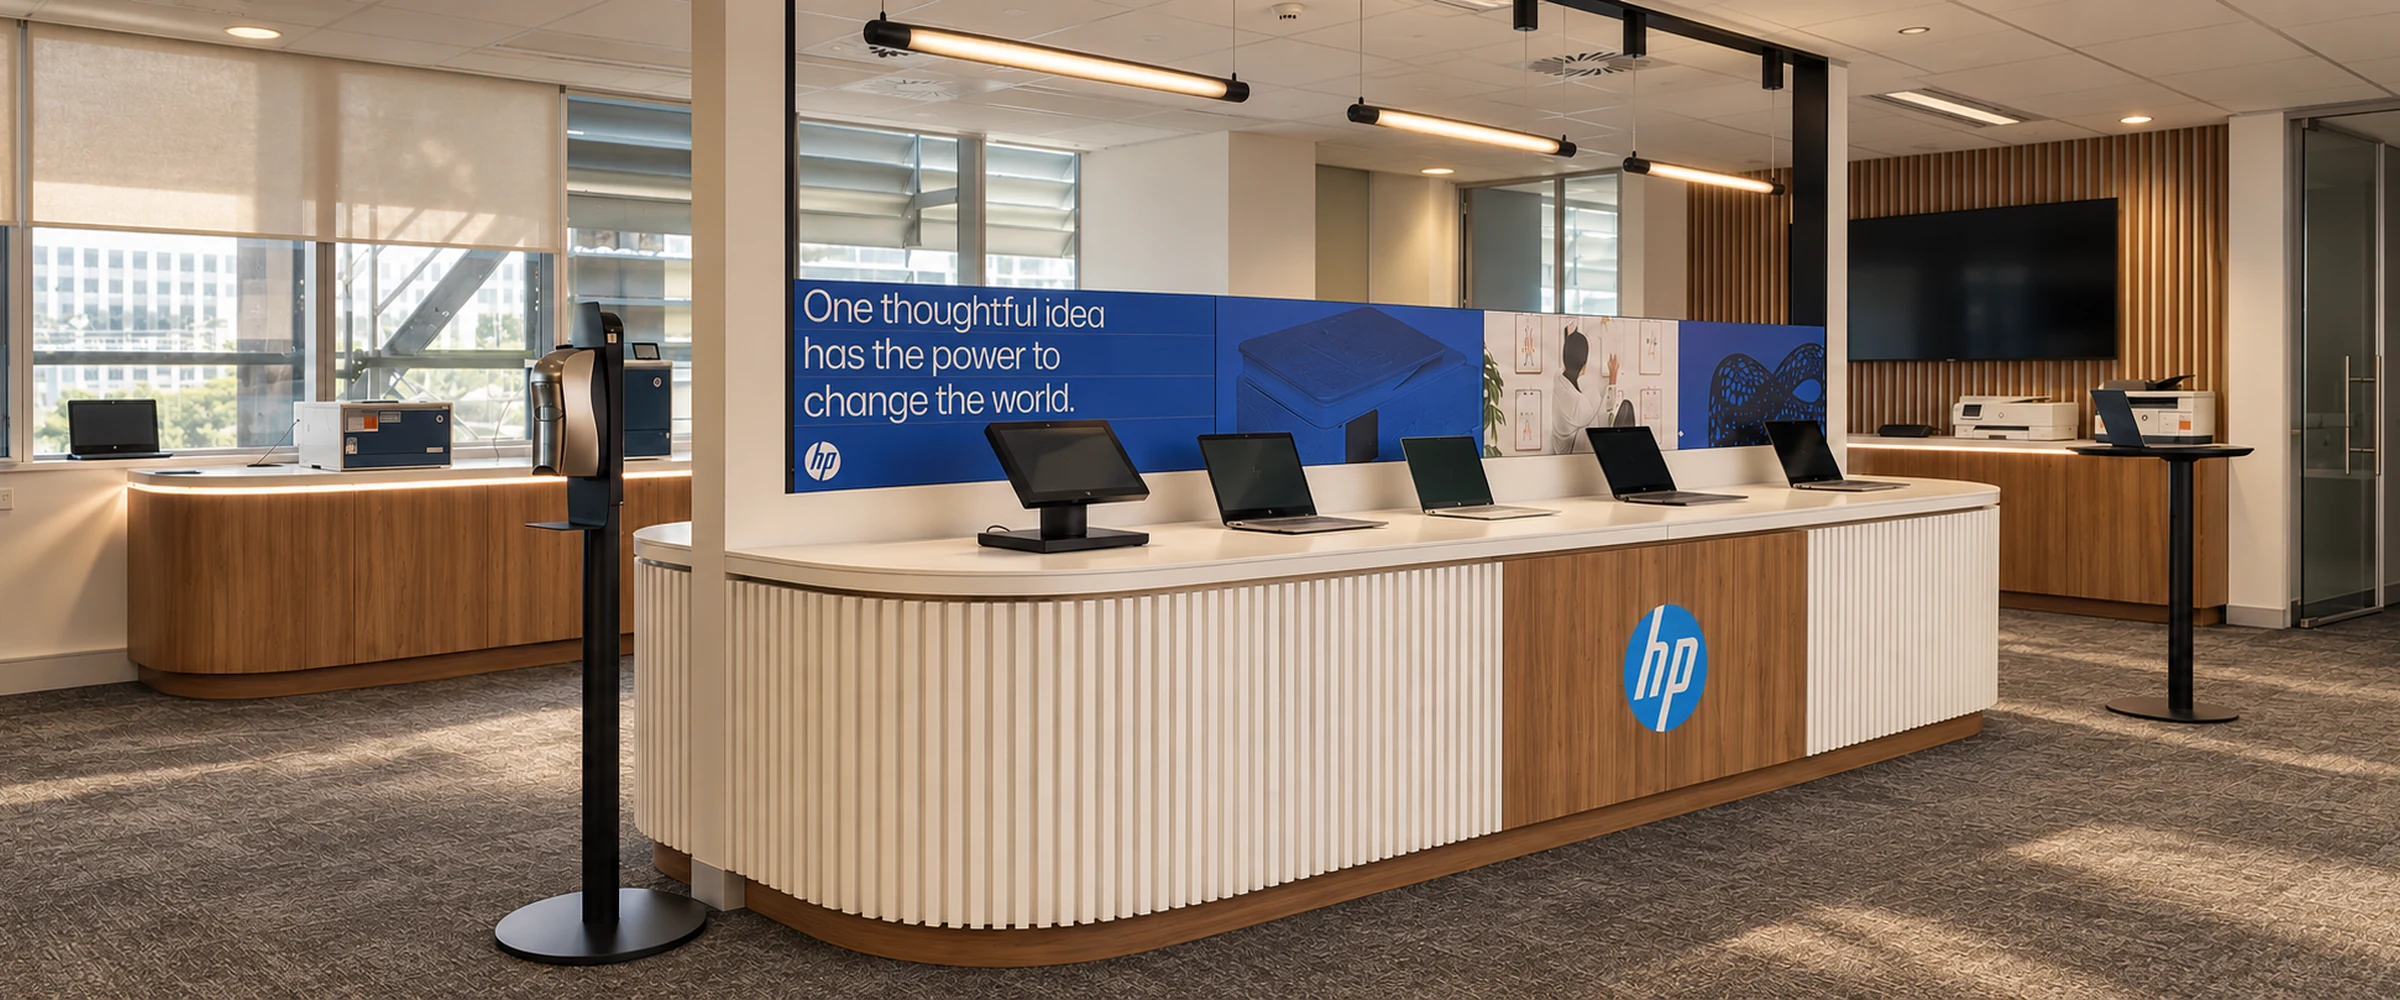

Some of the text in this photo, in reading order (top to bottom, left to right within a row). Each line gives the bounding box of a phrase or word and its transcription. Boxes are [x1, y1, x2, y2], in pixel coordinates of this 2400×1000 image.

[803, 288, 1105, 334] One thoughtful idea
[804, 336, 1061, 377] has the power to
[804, 382, 1075, 424] change the world.
[808, 441, 838, 481] hp
[1633, 604, 1699, 732] hp
